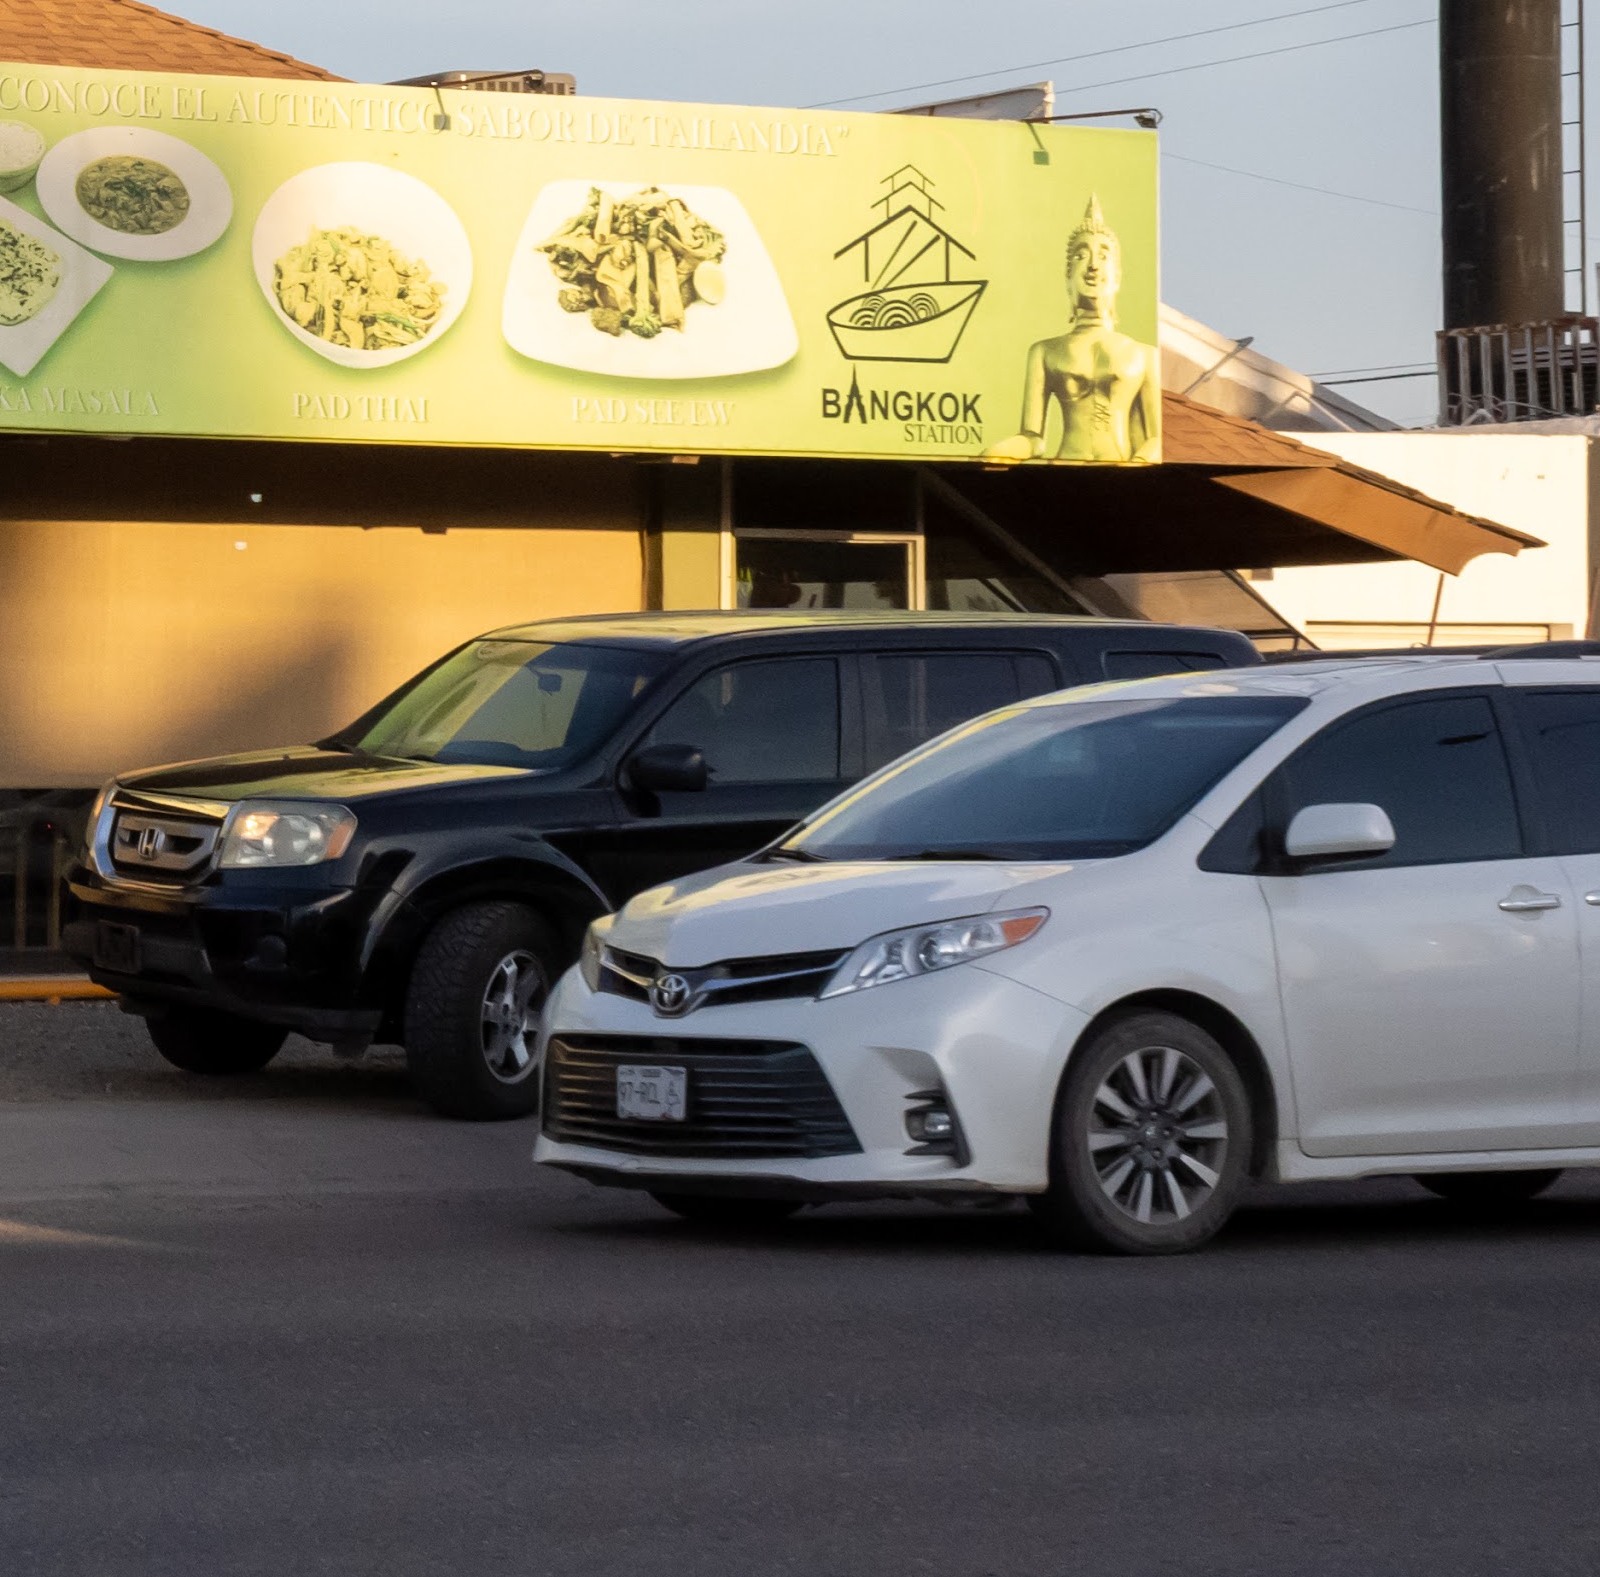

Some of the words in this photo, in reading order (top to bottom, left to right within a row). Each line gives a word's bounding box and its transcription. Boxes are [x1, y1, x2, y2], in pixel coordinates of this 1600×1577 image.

[171, 86, 218, 123] EL
[226, 89, 447, 137] AUTENTICO
[458, 102, 577, 145] SABOR
[585, 111, 637, 146] DE
[42, 385, 160, 417] MASALA
[293, 392, 351, 421] PAD
[358, 395, 430, 423] THAI
[571, 396, 628, 424] PAD
[821, 364, 983, 425] BANGKOK
[903, 423, 984, 445] STATION
